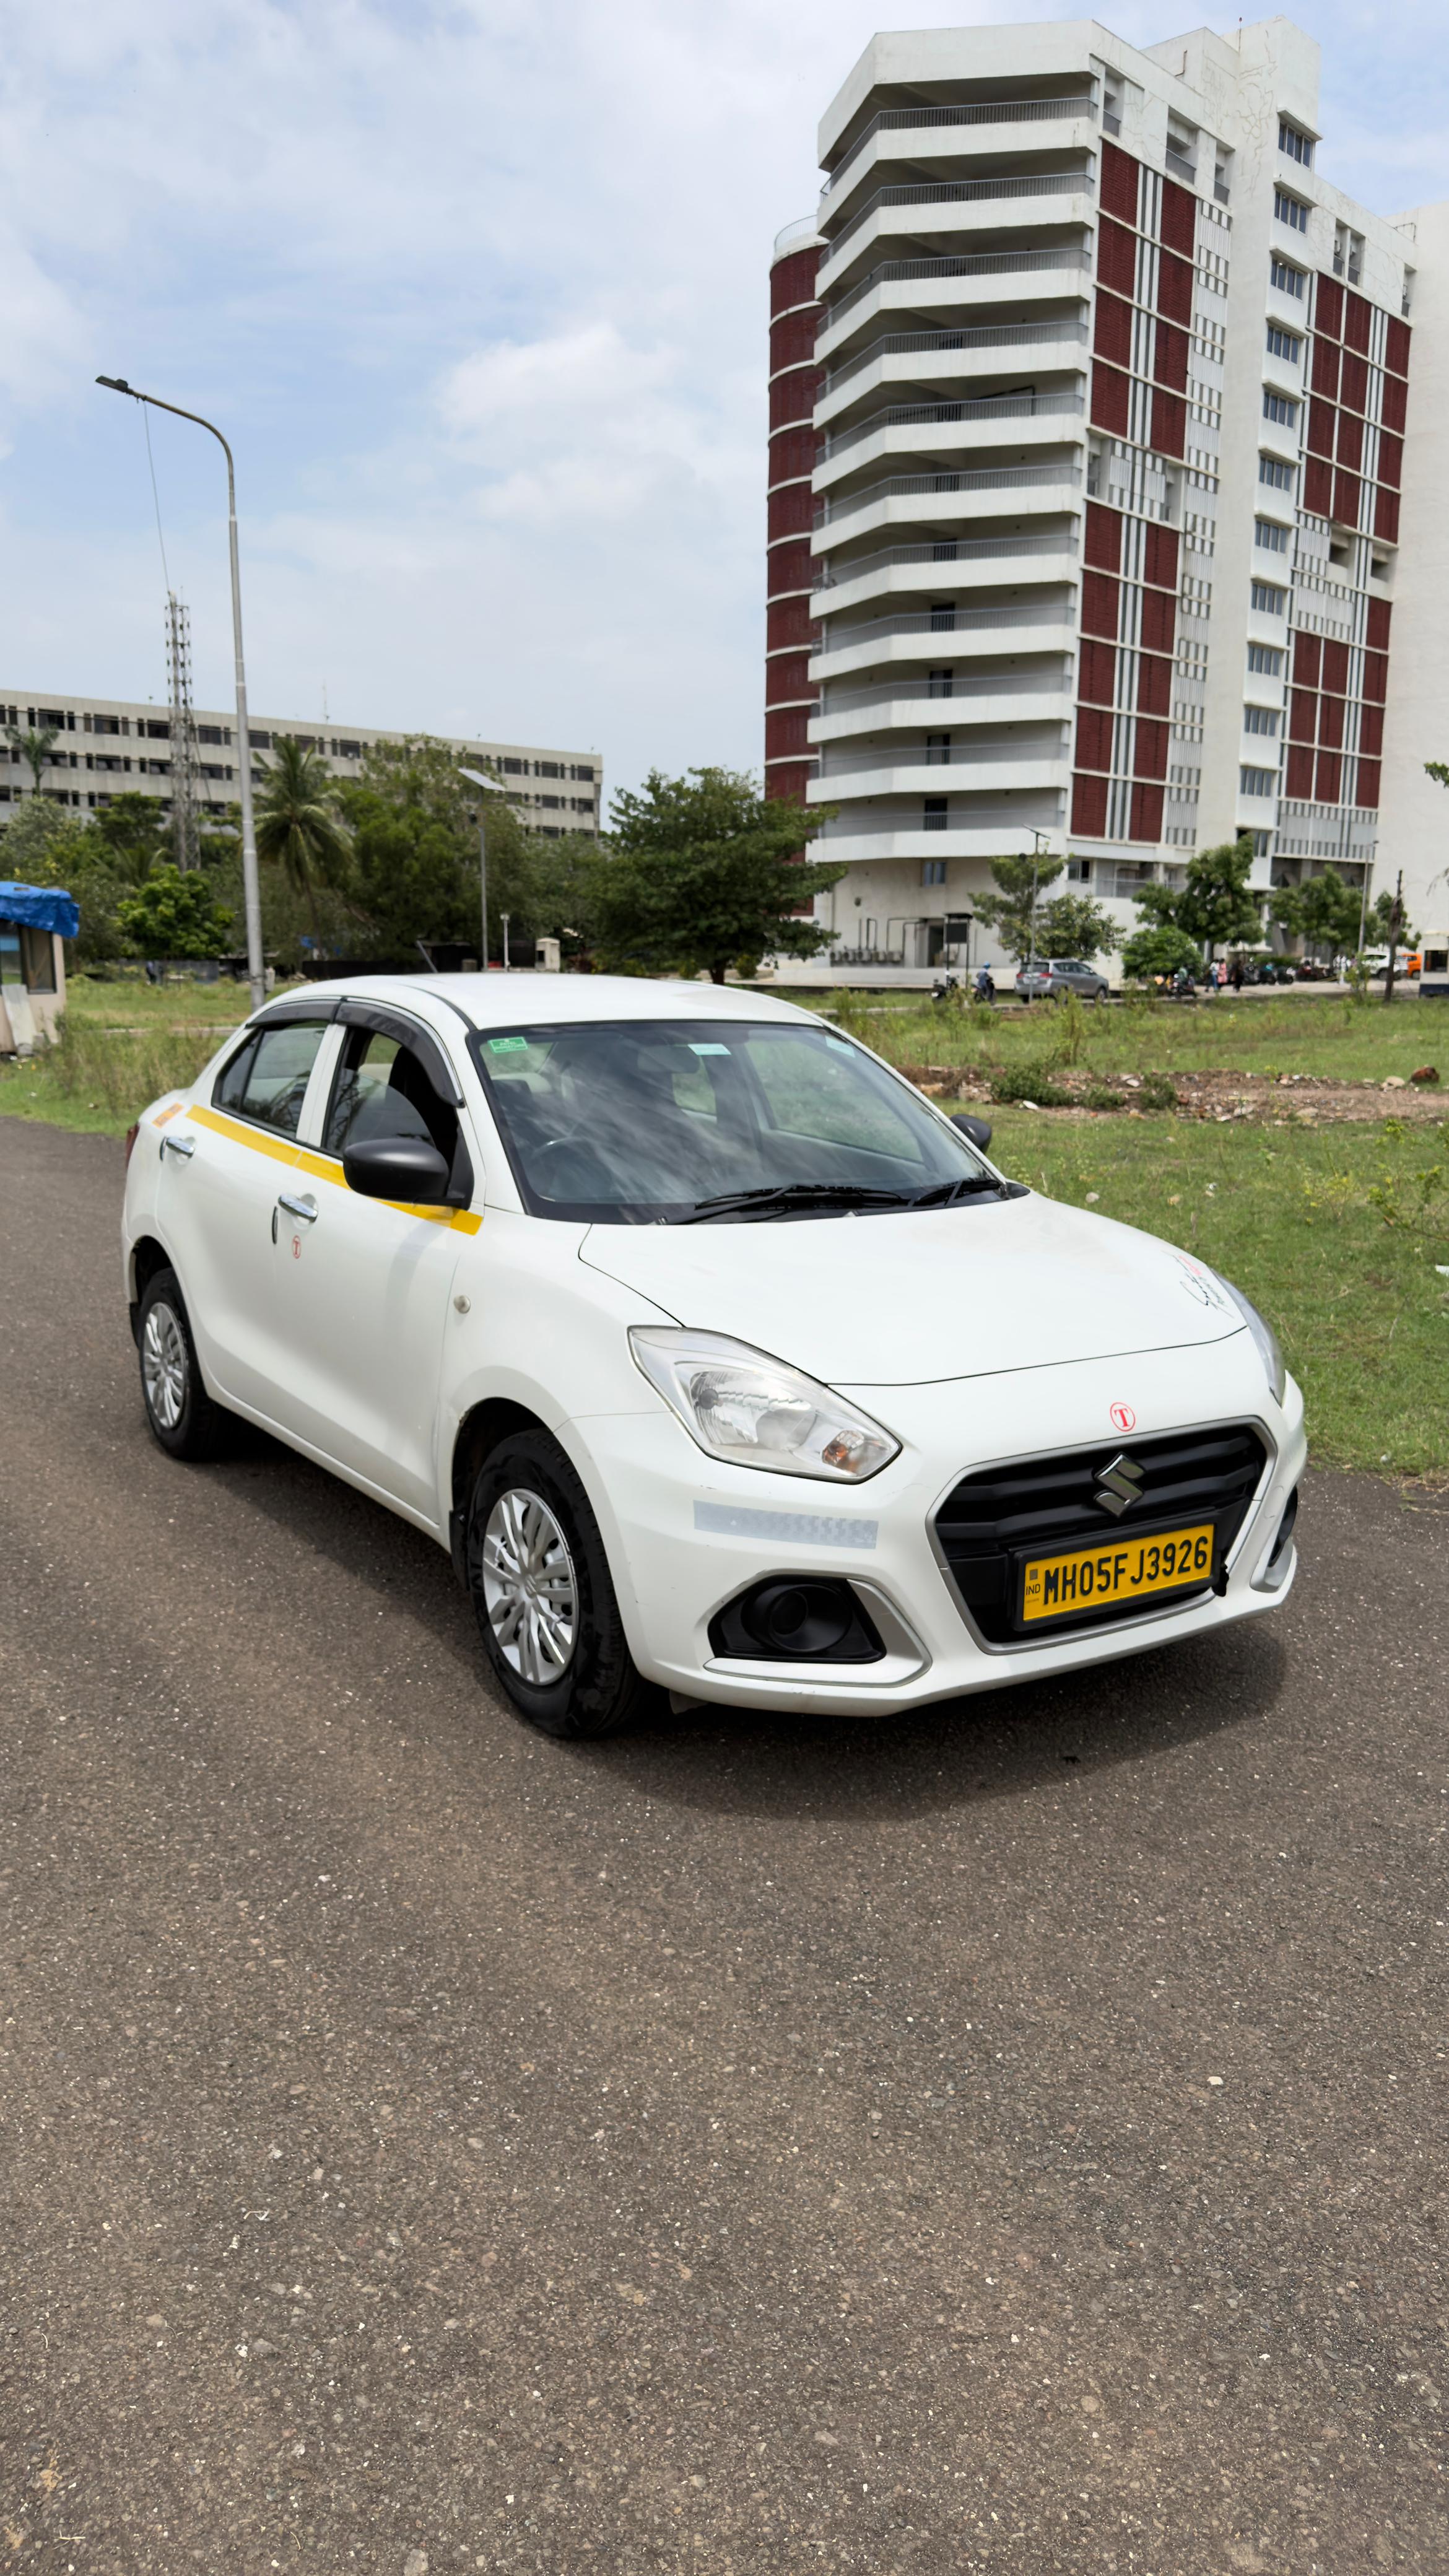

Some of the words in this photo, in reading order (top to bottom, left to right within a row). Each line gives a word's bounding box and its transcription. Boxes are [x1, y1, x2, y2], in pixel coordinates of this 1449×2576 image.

[1112, 1406, 1131, 1429] T
[1043, 1536, 1209, 1605] MH05FJ3926
[1025, 1583, 1041, 1596] IND
